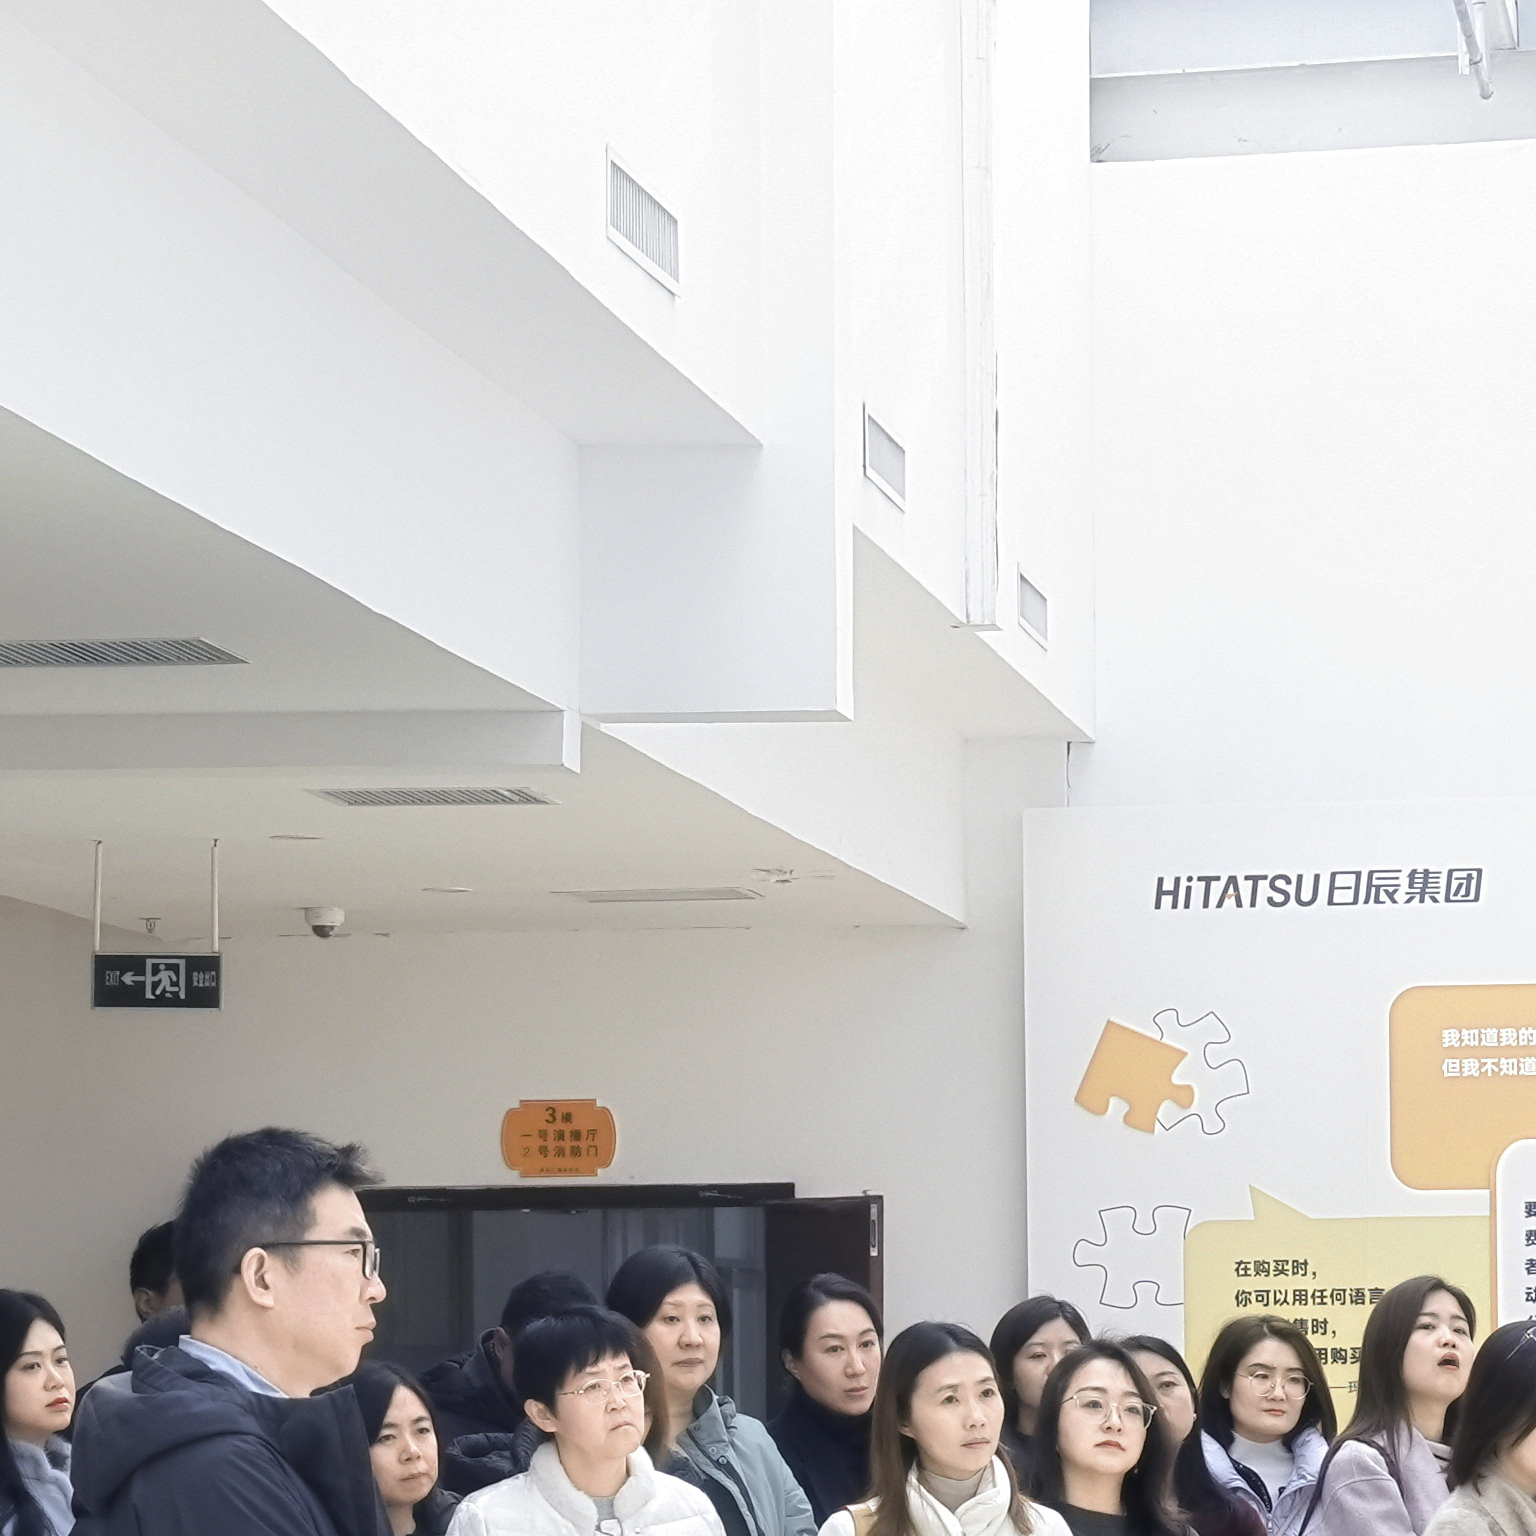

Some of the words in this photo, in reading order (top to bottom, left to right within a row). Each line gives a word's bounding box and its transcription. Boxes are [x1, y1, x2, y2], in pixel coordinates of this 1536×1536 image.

[1327, 868, 1483, 907] 日辰集团
[1234, 1259, 1318, 1280] 在购买时，
